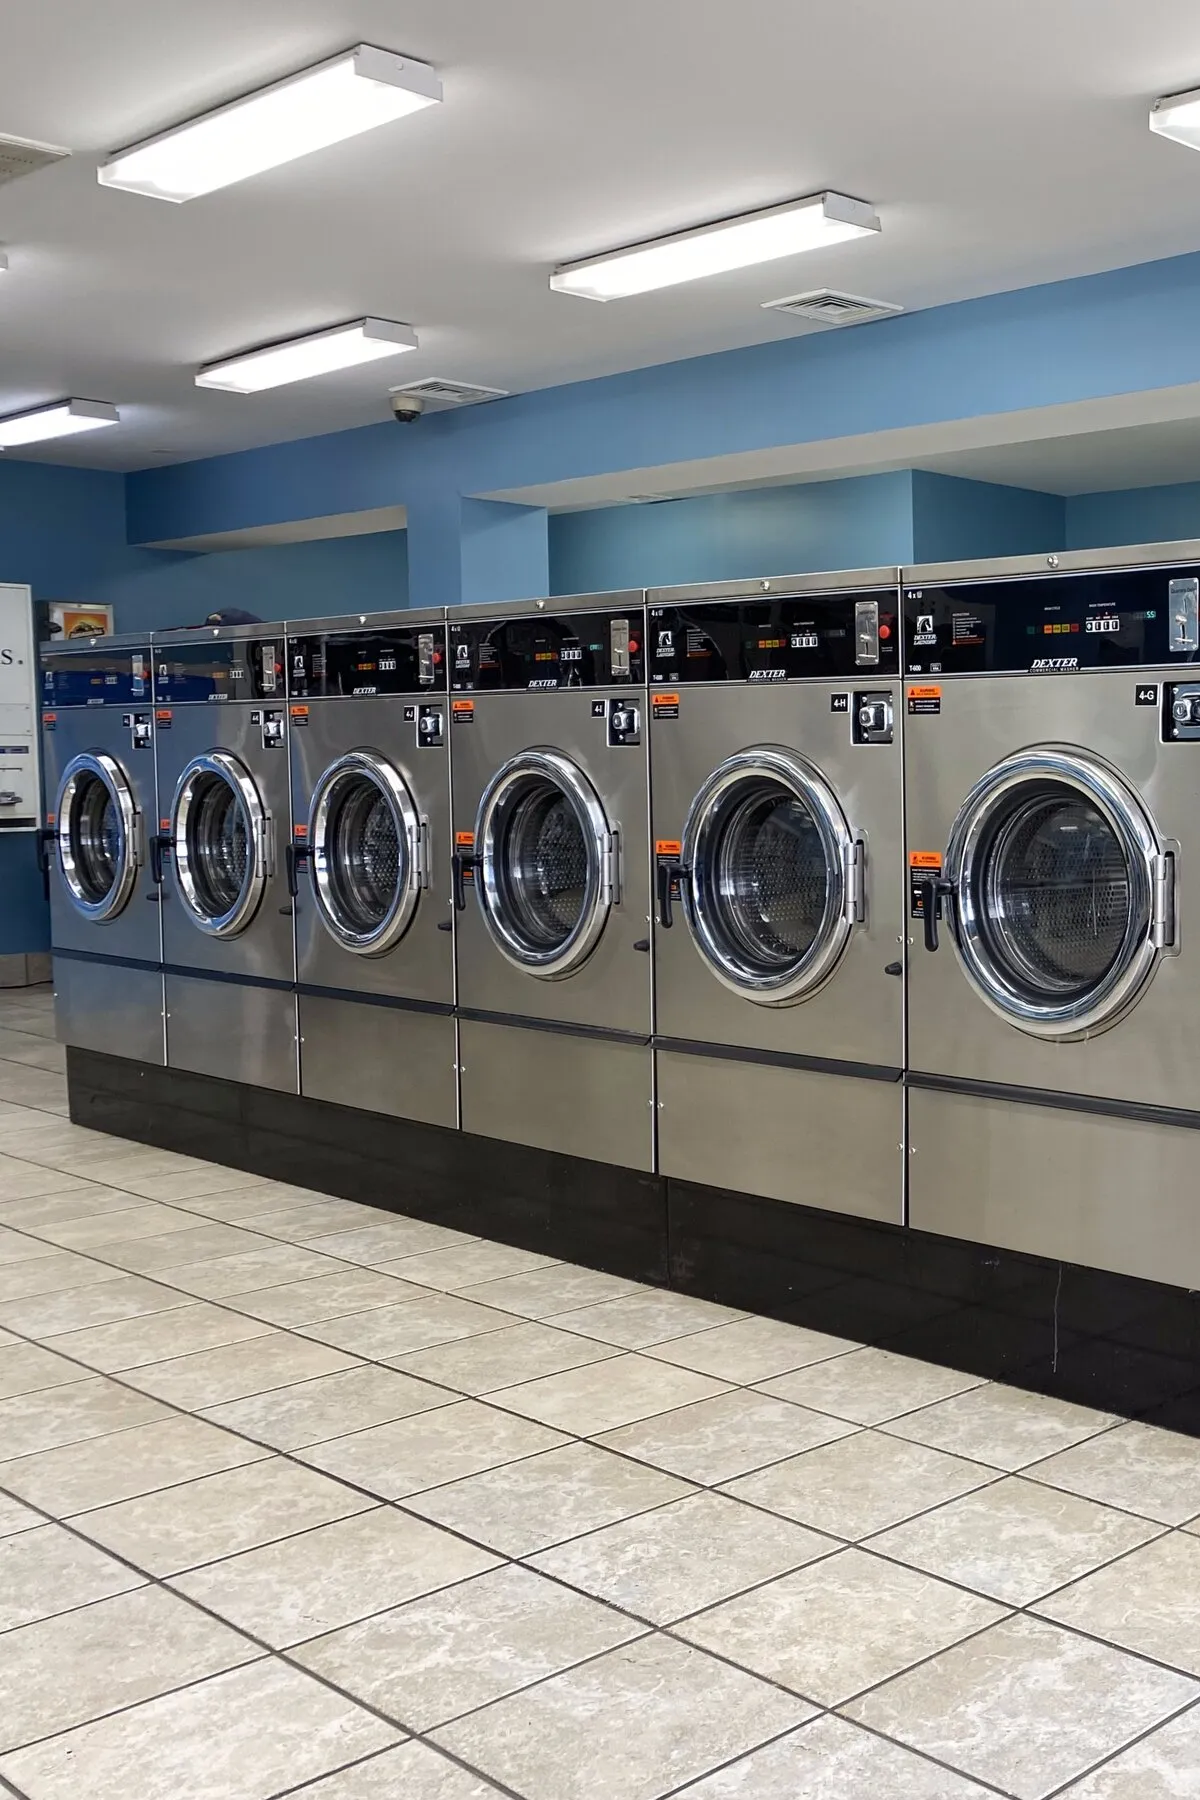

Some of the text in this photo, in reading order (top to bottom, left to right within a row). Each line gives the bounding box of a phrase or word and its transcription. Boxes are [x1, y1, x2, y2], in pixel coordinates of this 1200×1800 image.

[1031, 658, 1078, 668] DEXTER
[749, 670, 785, 678] DEXTER
[528, 680, 557, 688] DEXTER
[1139, 691, 1154, 700] 4-G
[834, 699, 846, 707] 4-H
